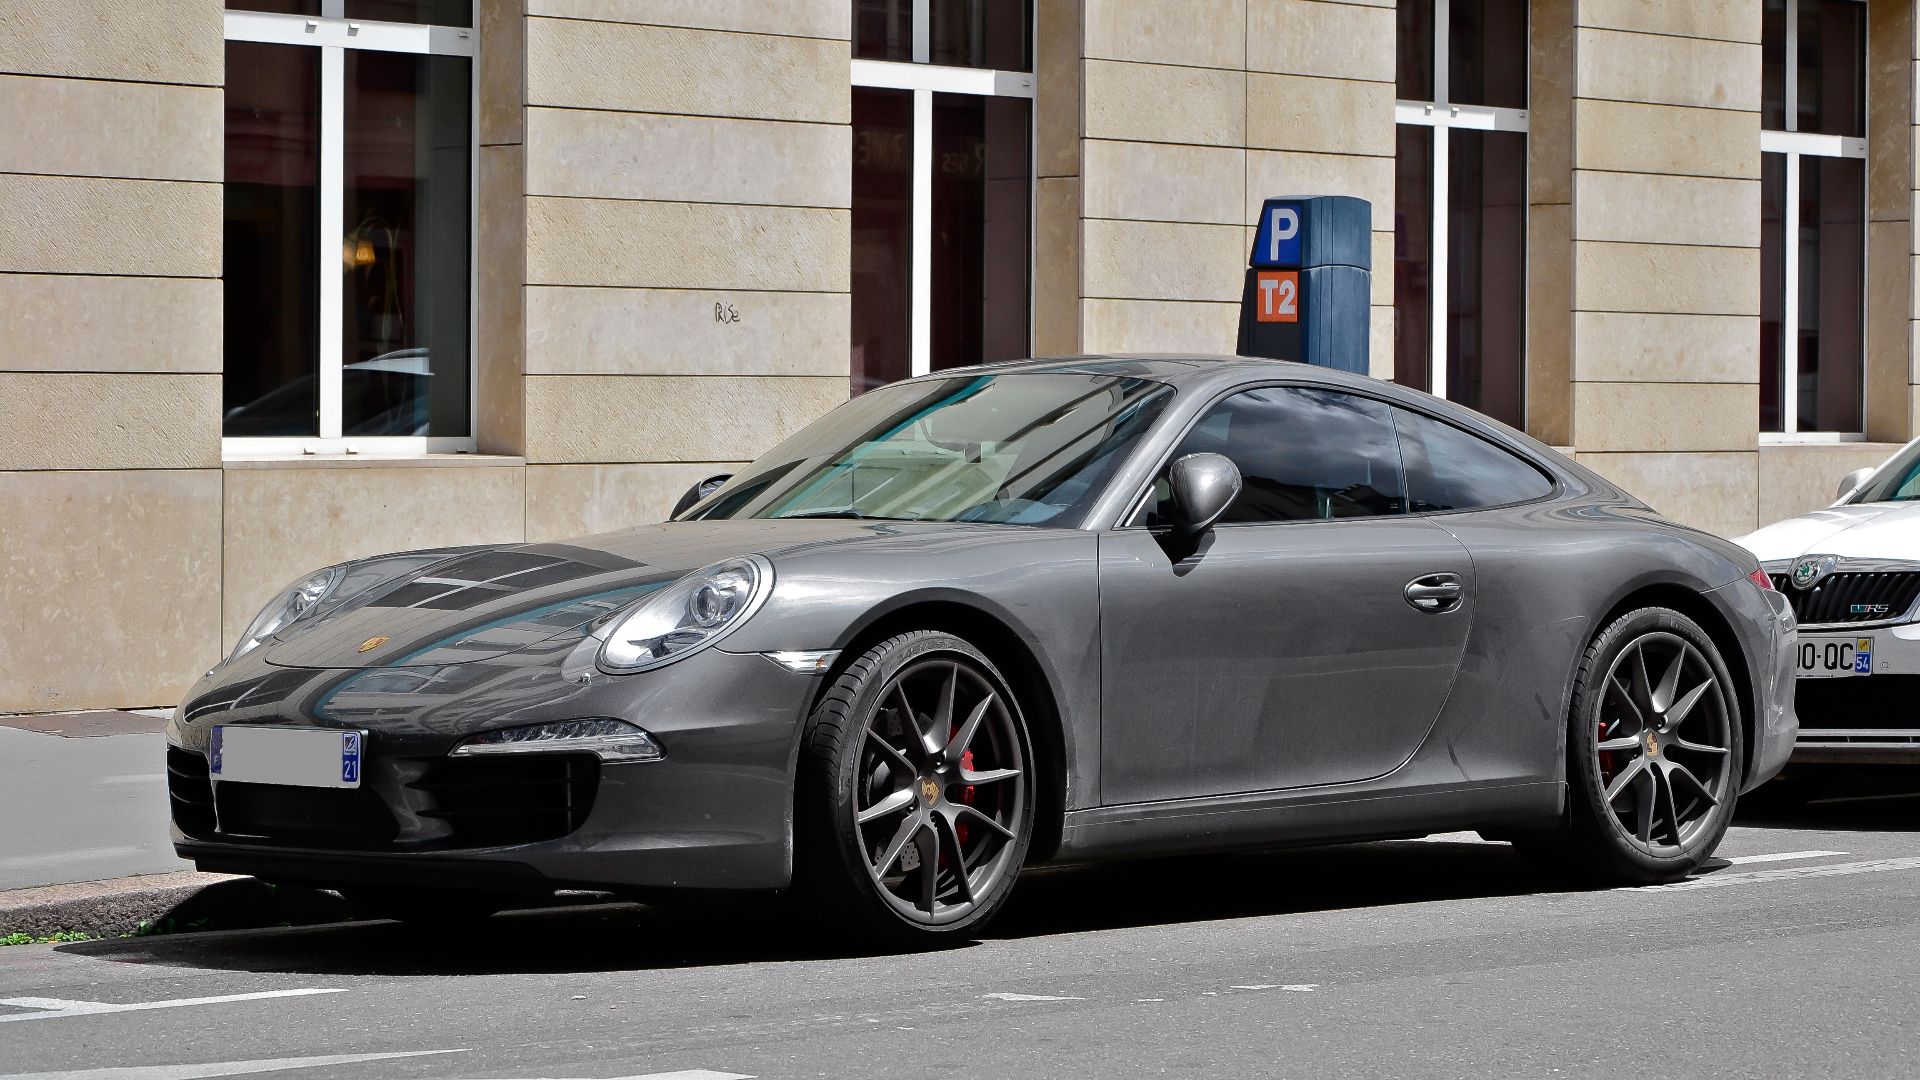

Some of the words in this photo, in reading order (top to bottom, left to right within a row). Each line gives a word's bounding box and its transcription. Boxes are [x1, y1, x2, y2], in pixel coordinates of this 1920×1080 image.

[1270, 208, 1299, 261] P
[1260, 279, 1296, 315] T2
[1856, 656, 1869, 670] 54
[344, 760, 357, 779] 21
